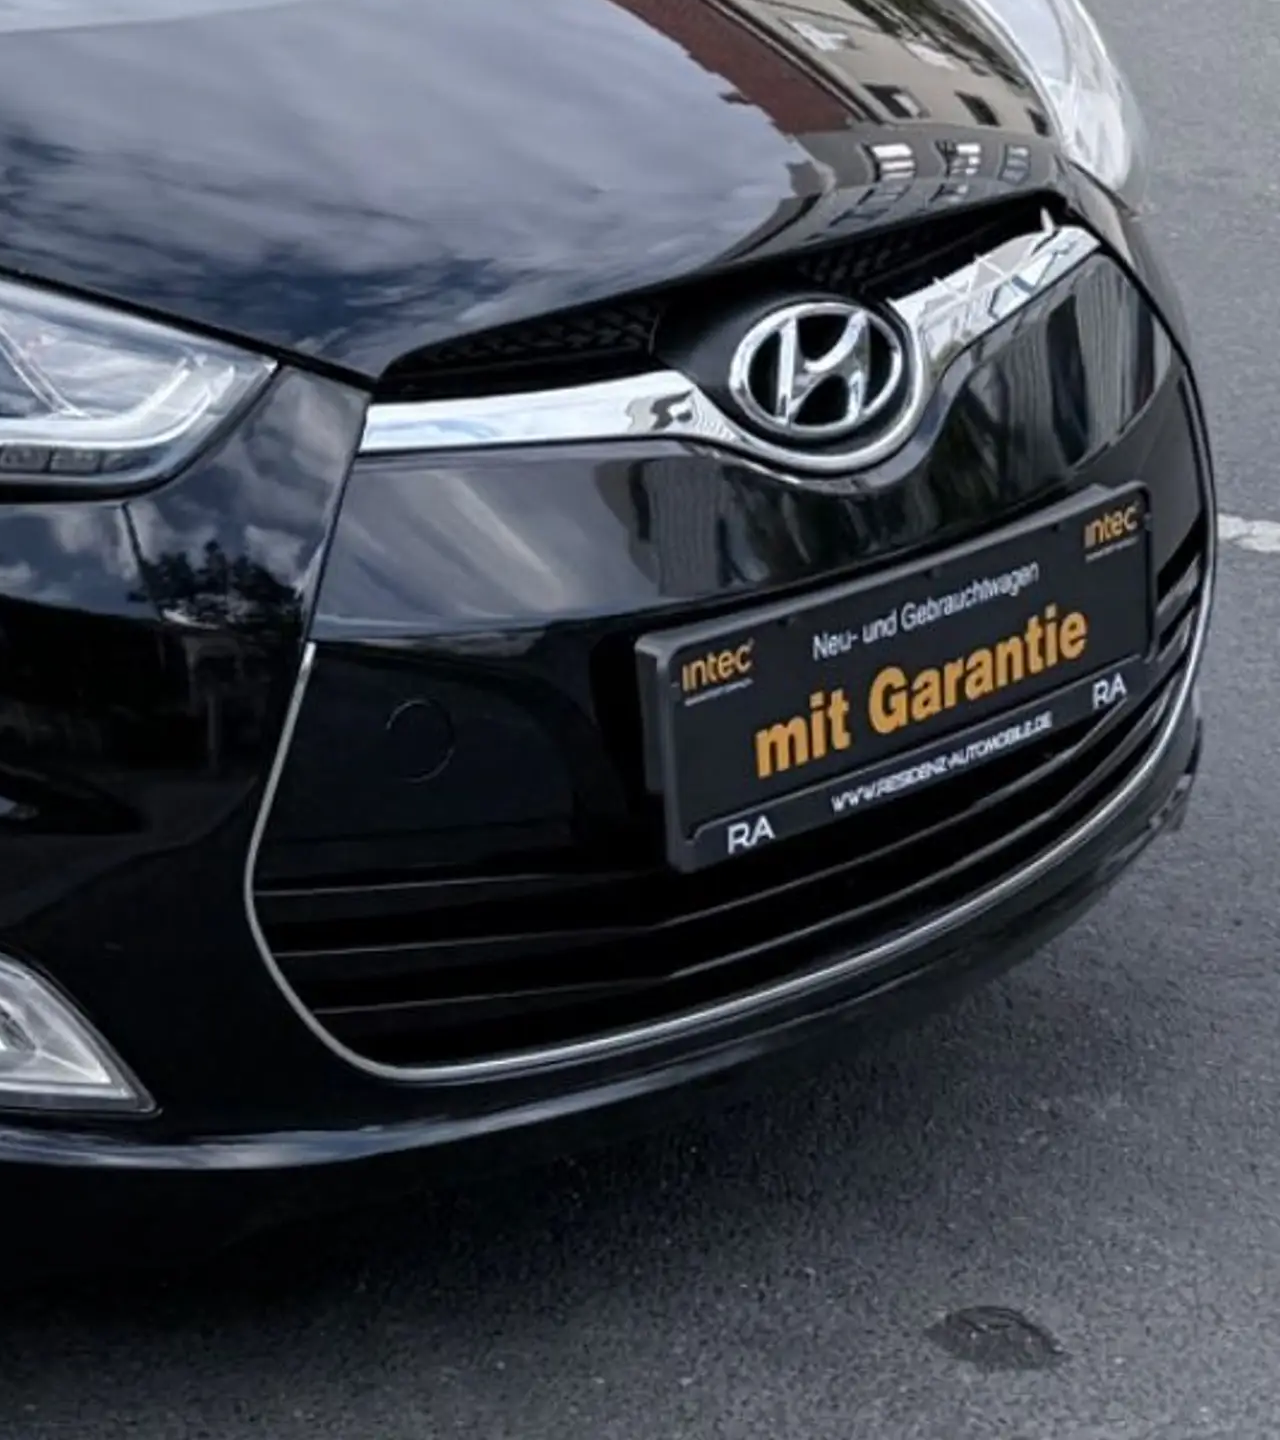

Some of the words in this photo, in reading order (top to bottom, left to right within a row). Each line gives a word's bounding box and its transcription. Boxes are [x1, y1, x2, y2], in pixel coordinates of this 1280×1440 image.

[812, 631, 858, 662] Neu-
[862, 609, 897, 644] und
[900, 560, 1040, 632] Gebrauchtwagen
[754, 687, 852, 779] mit
[868, 602, 1089, 735] Garantie
[1092, 672, 1128, 710] RA
[727, 814, 777, 855] RA
